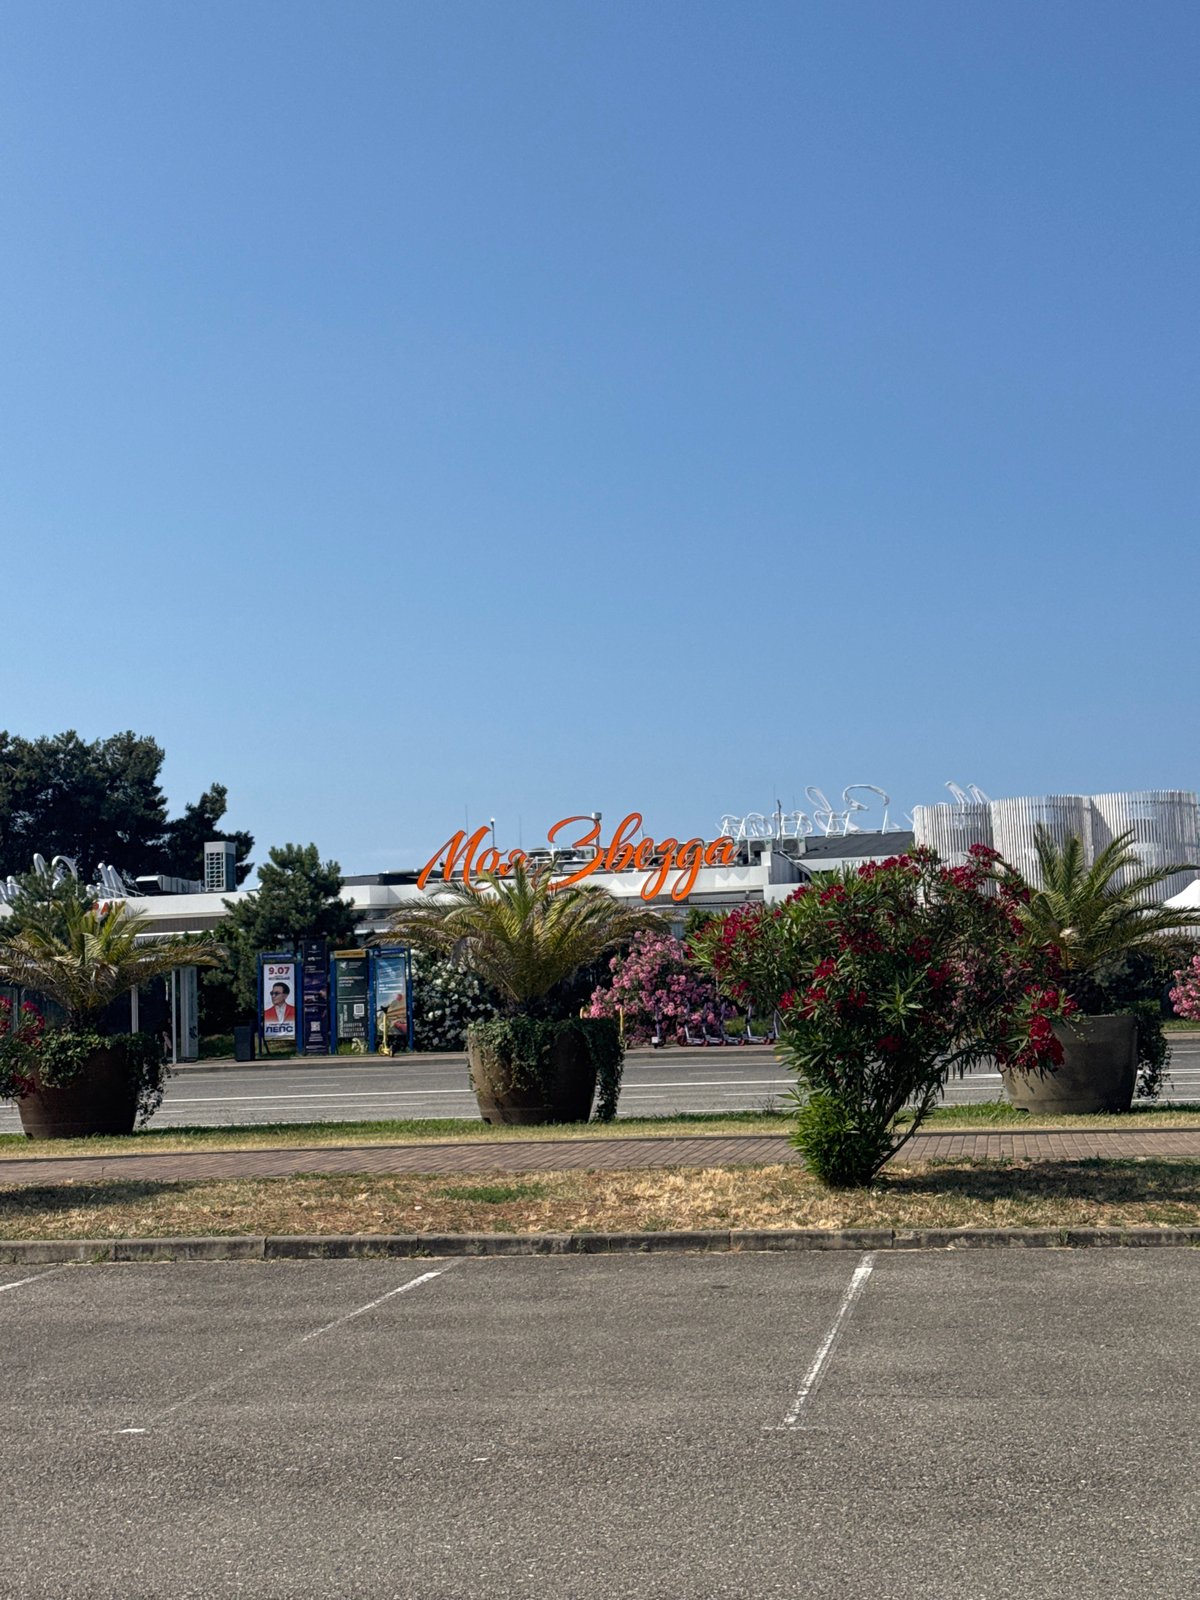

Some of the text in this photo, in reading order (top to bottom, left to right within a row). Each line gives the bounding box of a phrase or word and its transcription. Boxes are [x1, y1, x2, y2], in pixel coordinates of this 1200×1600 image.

[416, 812, 741, 902] Моя Звезда
[268, 967, 290, 975] 9.07
